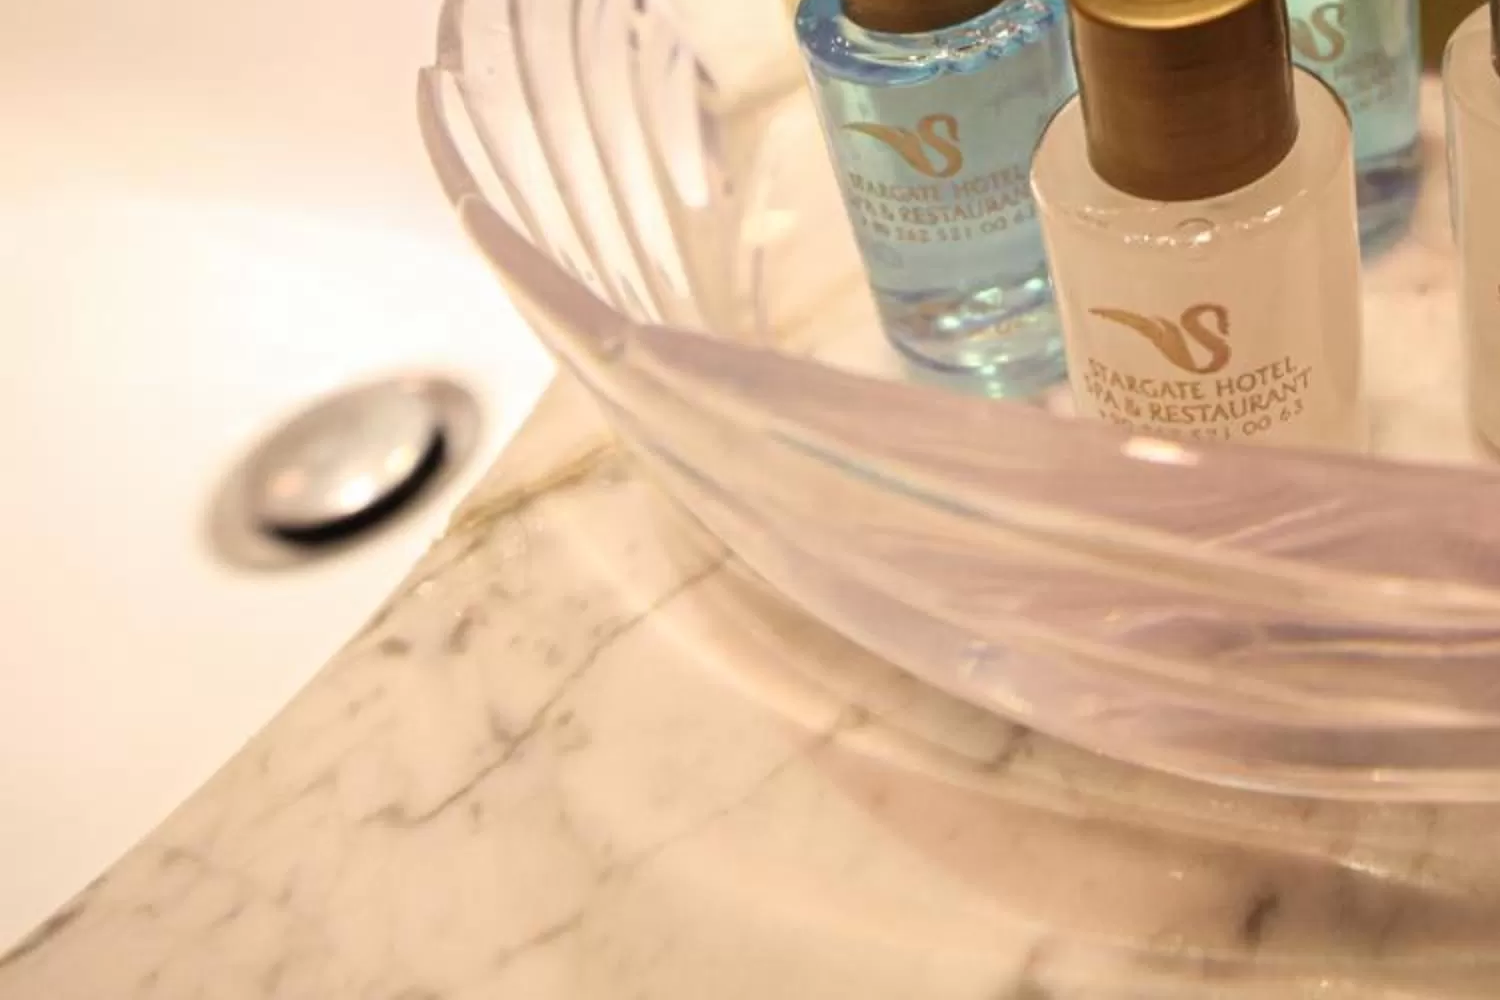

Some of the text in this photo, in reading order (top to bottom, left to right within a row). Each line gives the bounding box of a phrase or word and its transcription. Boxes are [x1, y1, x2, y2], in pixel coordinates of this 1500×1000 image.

[1087, 355, 1298, 402] STARGATE HOTEL
[1149, 365, 1313, 424] RESTAURANT
[1242, 414, 1271, 436] 00
